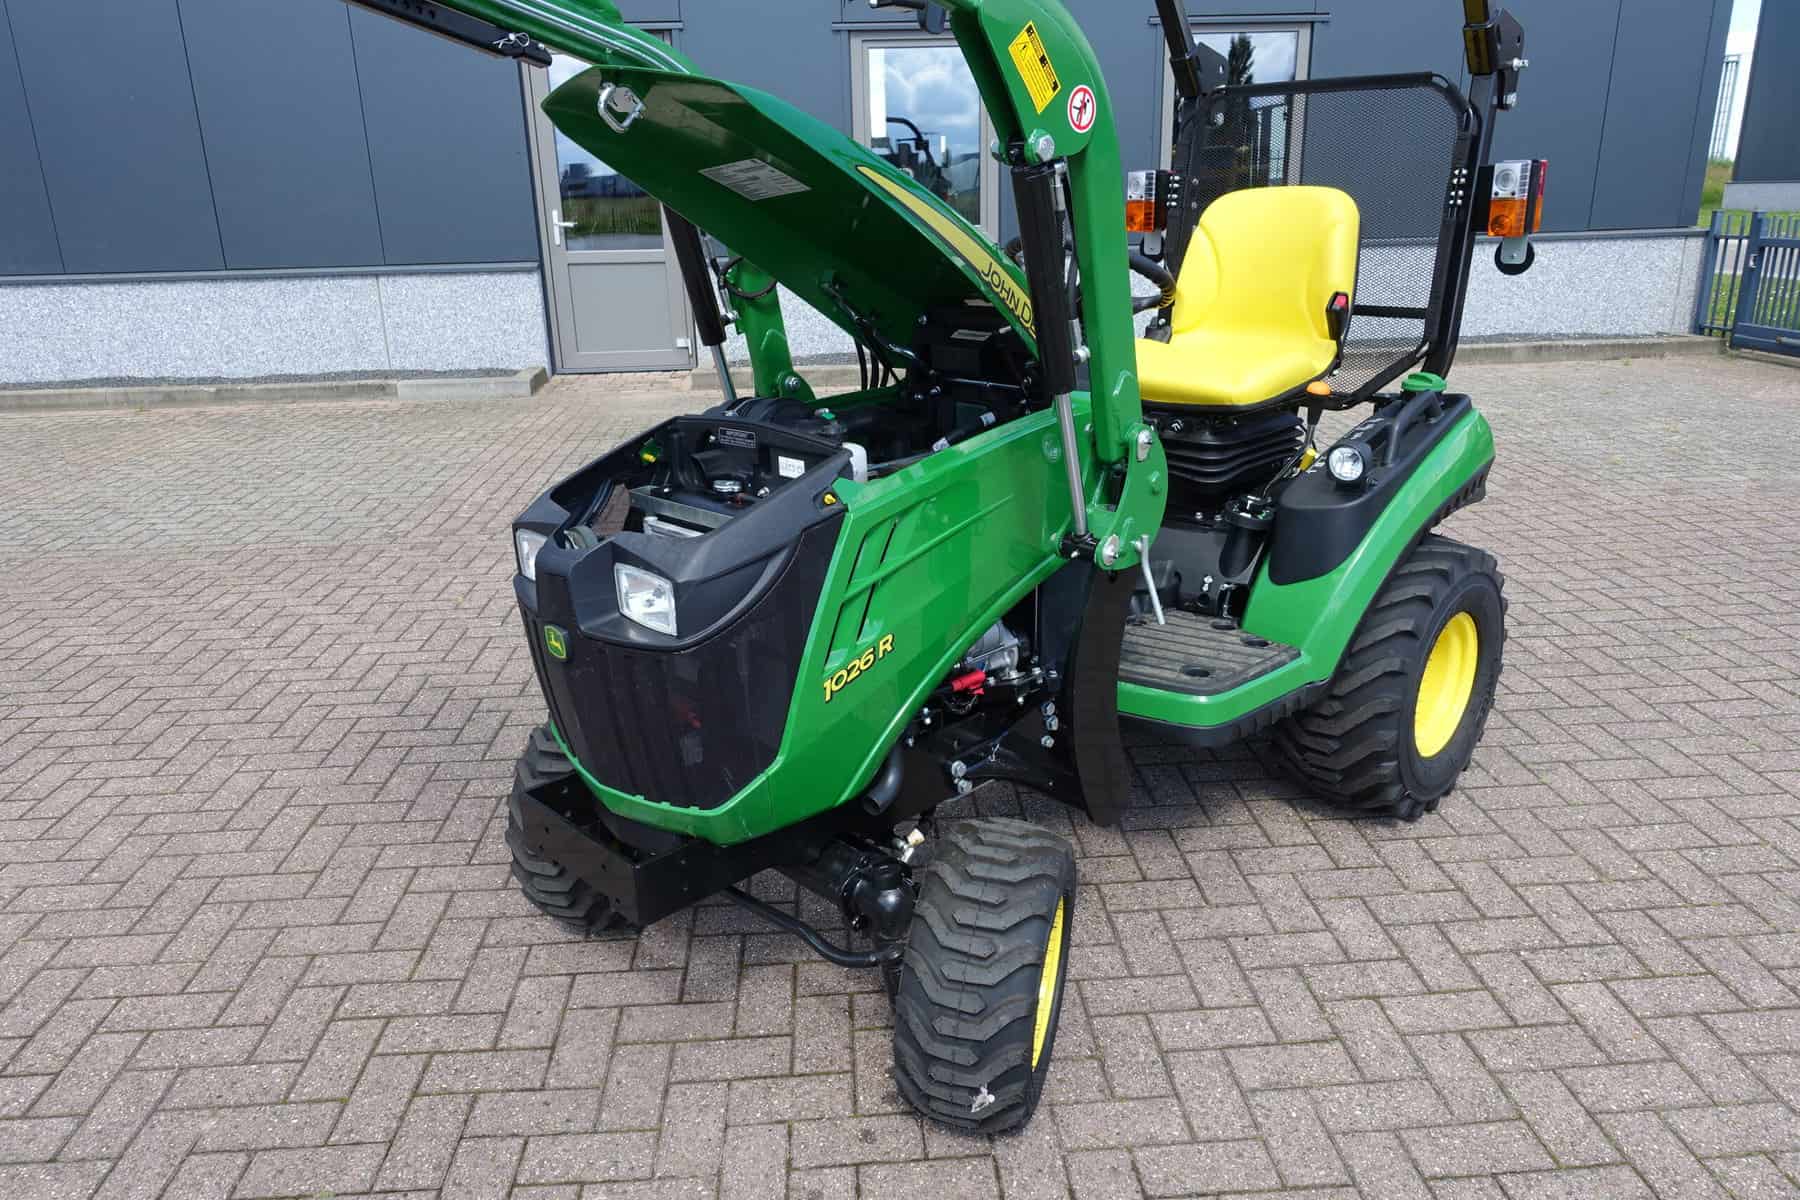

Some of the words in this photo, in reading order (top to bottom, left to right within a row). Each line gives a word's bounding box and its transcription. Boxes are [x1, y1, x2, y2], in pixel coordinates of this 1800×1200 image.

[981, 261, 1020, 312] JOHN
[1021, 302, 1037, 336] D
[823, 646, 875, 702] 1026
[878, 633, 894, 659] R
